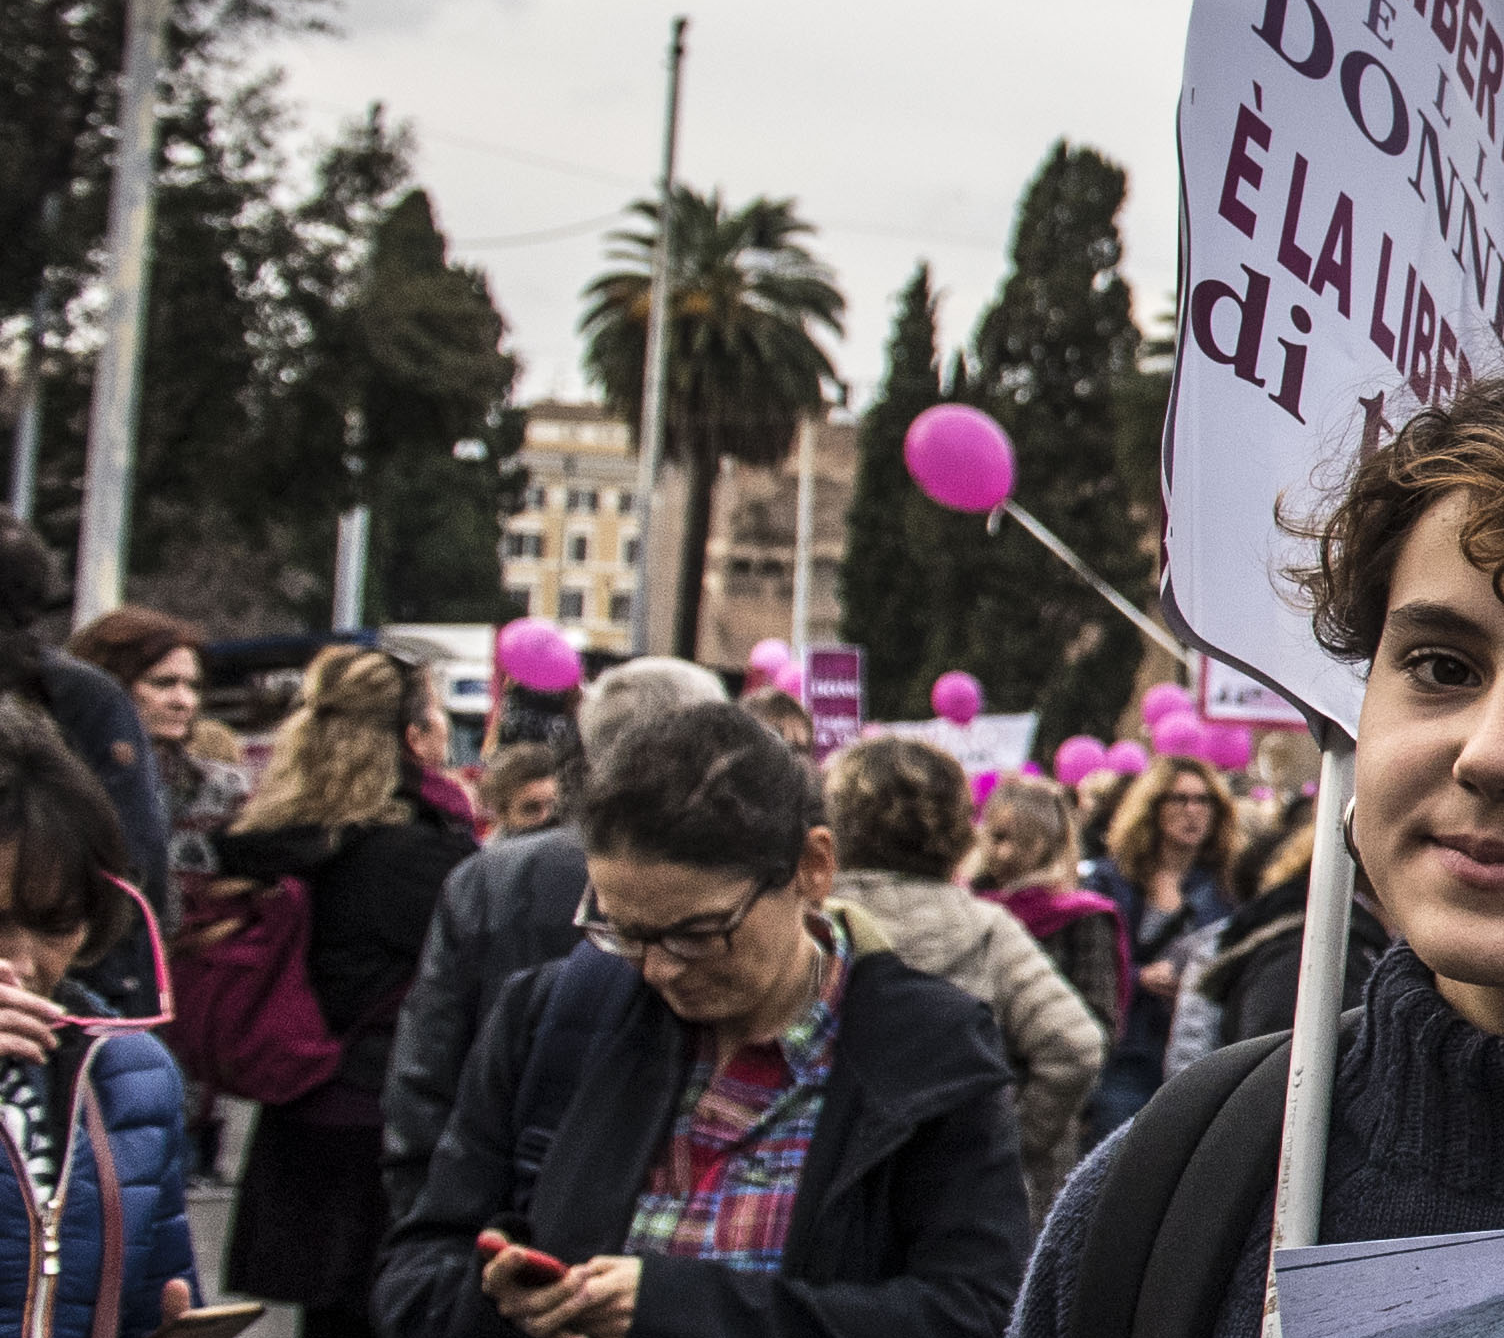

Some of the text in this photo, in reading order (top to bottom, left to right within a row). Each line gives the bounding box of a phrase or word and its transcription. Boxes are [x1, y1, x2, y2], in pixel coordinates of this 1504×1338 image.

[1218, 80, 1272, 241] È
[1277, 151, 1354, 321] LA
[1191, 263, 1312, 426] di
